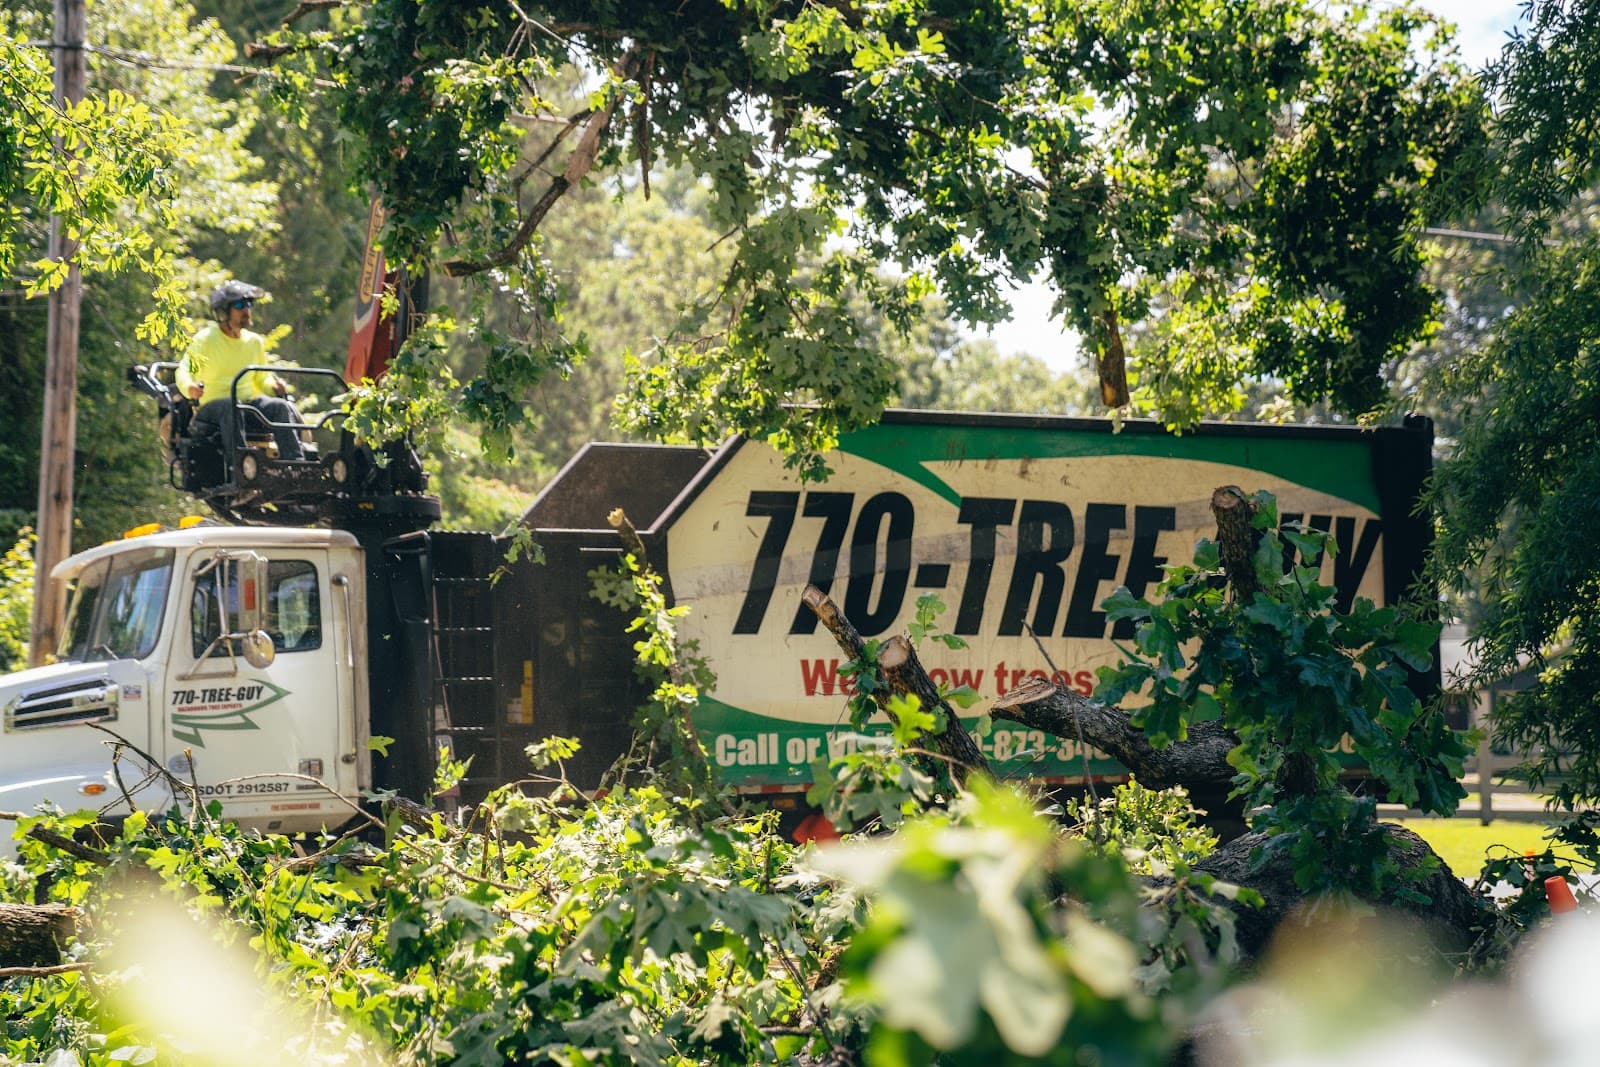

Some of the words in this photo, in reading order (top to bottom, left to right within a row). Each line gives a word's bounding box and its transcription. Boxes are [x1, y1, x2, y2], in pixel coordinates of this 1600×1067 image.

[363, 204, 384, 296] PALFINER
[732, 490, 1382, 639] 770-TREE-Y
[172, 686, 264, 705] 770-TREE-GUY
[715, 733, 779, 767] Call
[786, 738, 821, 765] or
[198, 784, 233, 796] SDOT
[237, 782, 289, 794] 2912587
